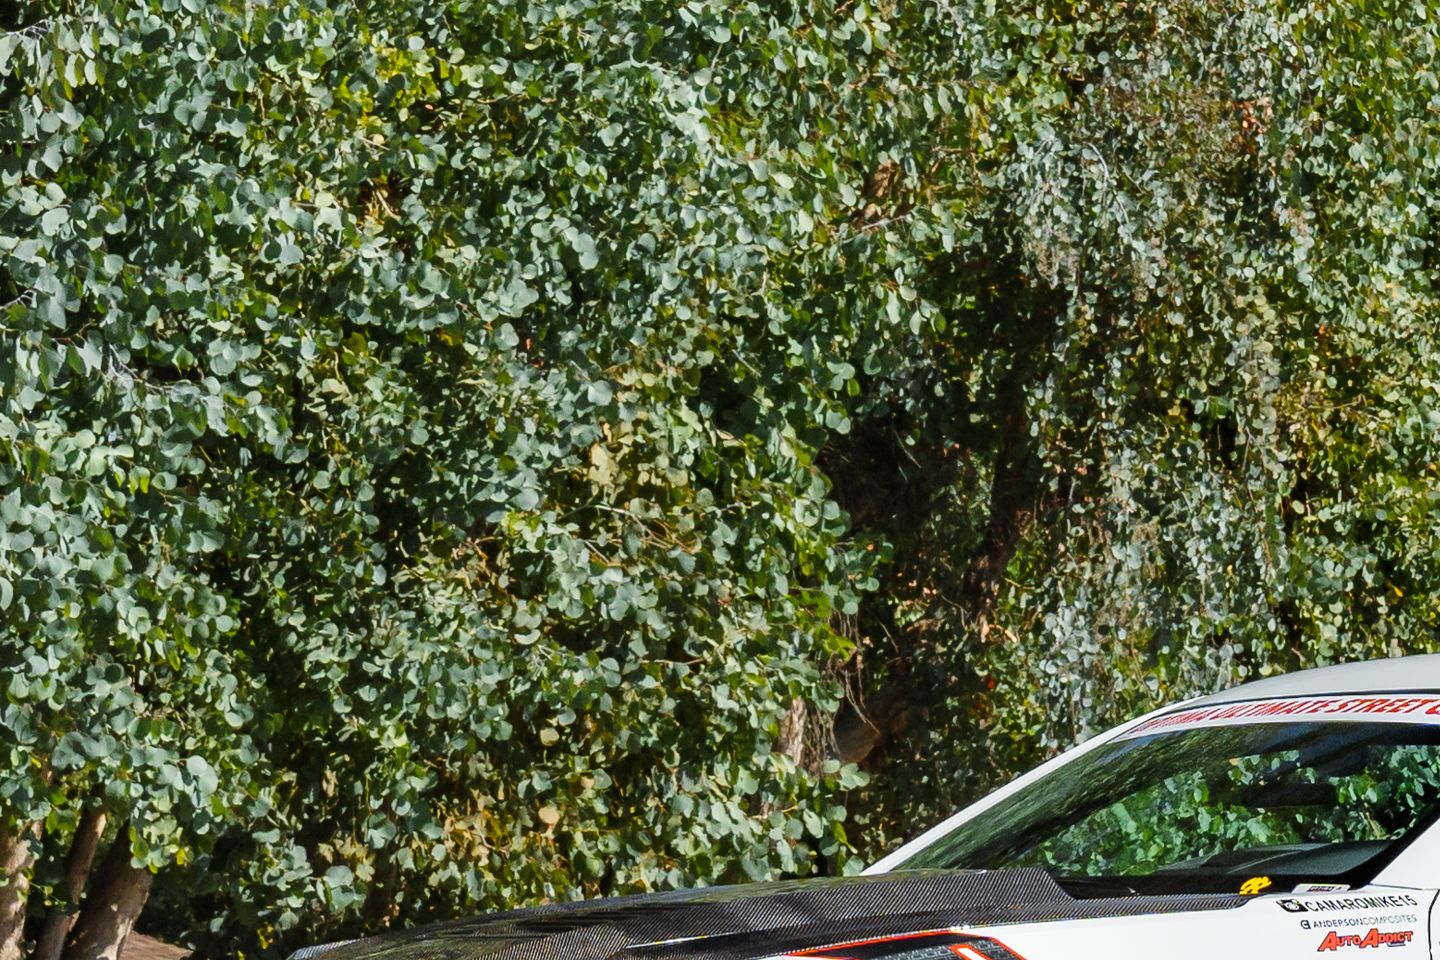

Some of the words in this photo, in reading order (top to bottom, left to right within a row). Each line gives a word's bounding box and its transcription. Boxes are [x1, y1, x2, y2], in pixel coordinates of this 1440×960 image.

[1209, 700, 1342, 720] ULTIMATE
[1324, 698, 1440, 713] STREET
[1305, 895, 1418, 912] CAMAROMIKE15
